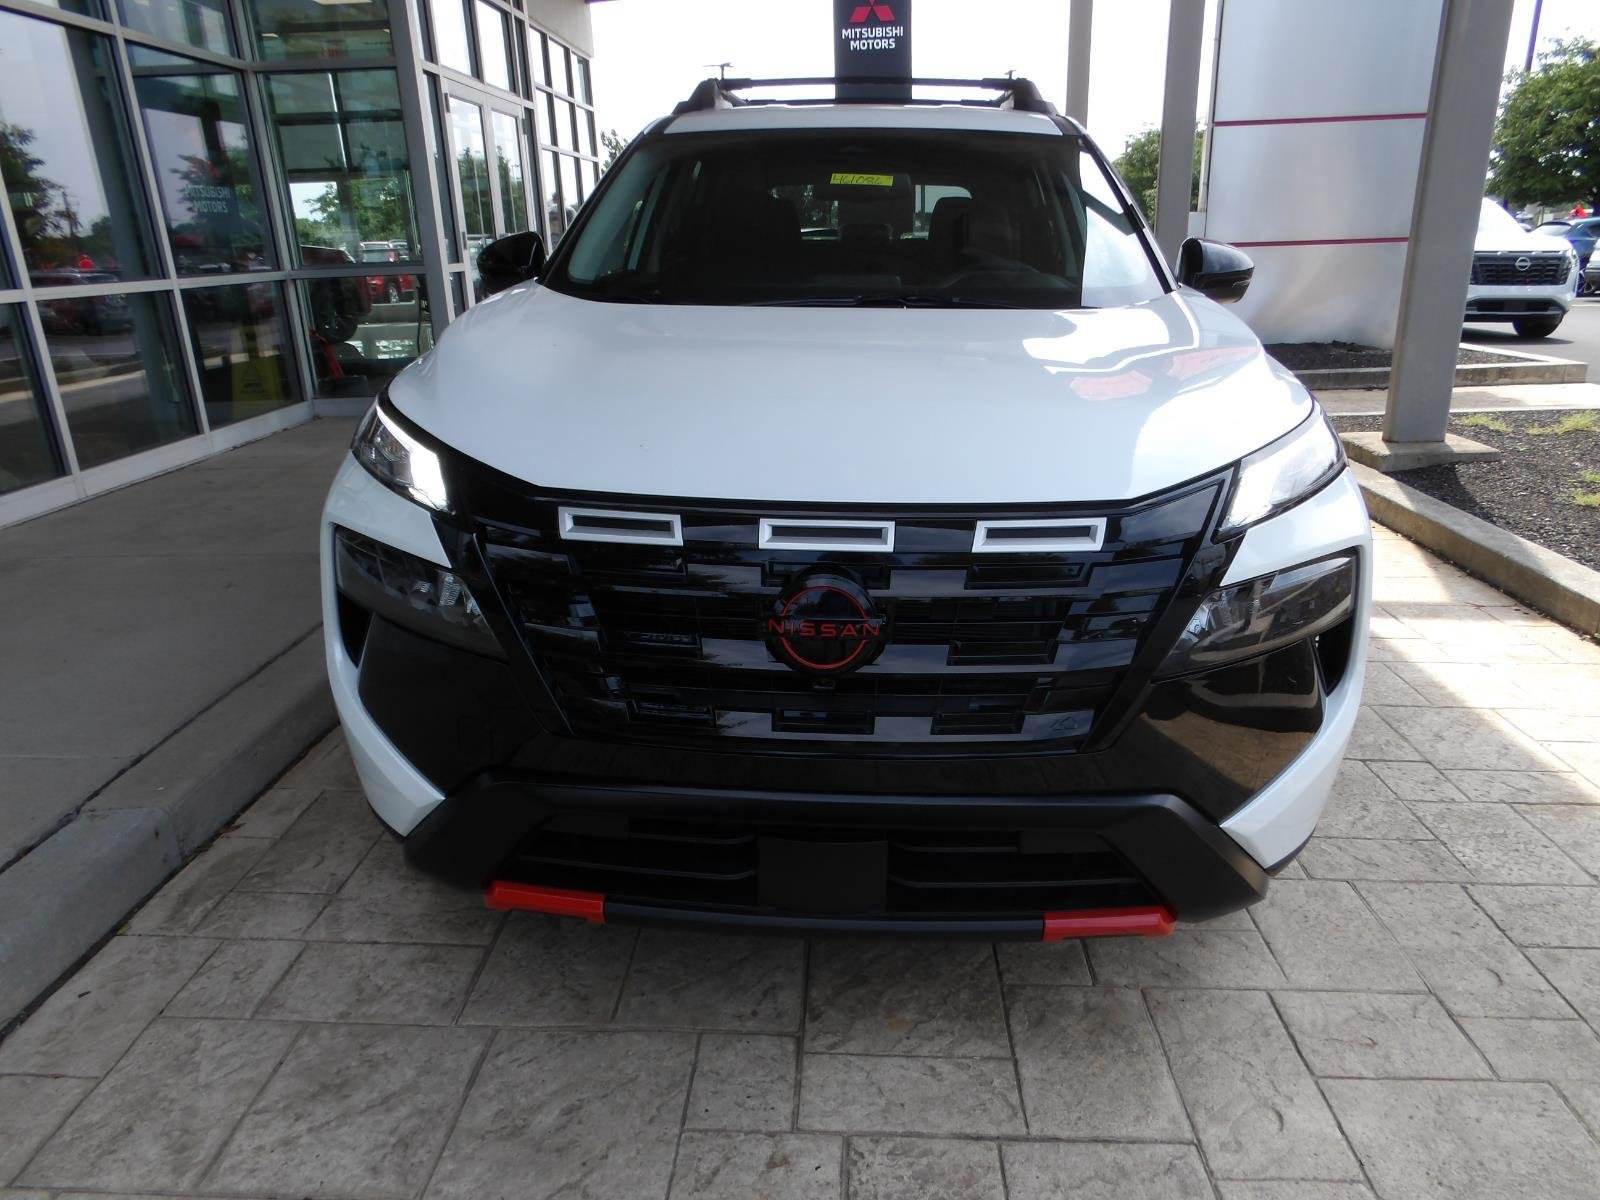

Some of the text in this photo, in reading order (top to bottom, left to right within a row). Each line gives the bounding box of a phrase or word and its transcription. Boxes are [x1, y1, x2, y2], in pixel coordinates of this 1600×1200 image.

[841, 26, 904, 39] MITSUBISHI
[850, 38, 896, 51] MOTORS
[767, 618, 881, 637] NISSAN
